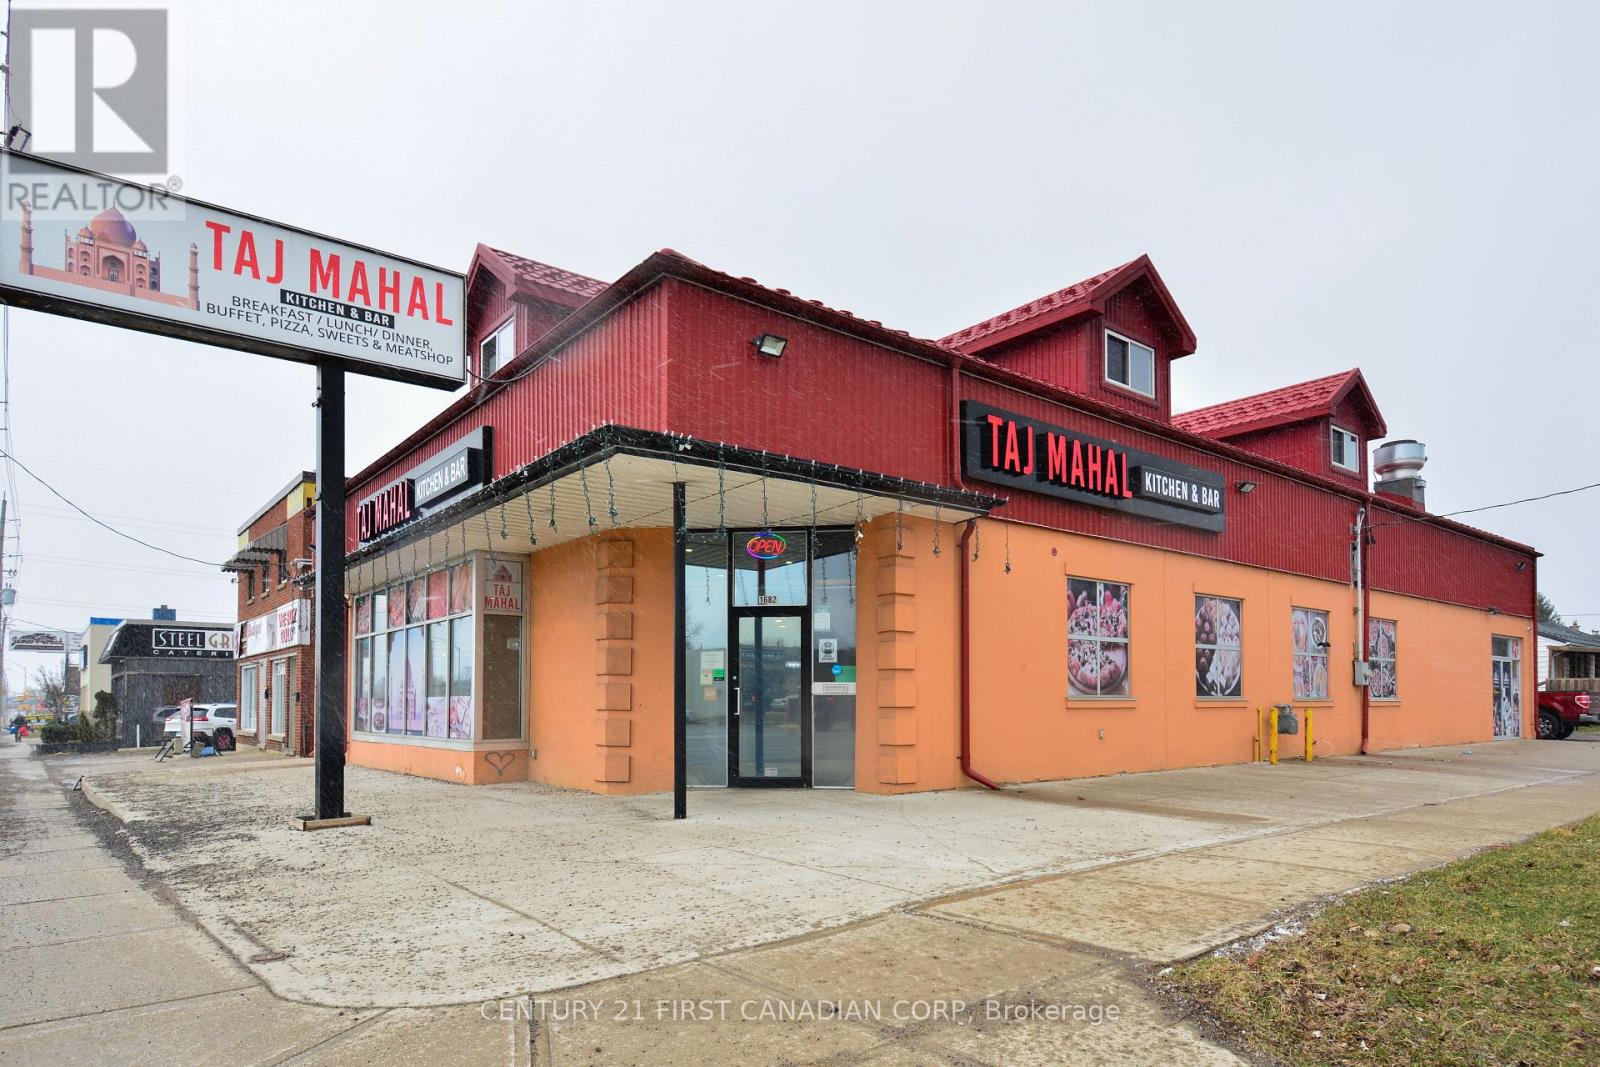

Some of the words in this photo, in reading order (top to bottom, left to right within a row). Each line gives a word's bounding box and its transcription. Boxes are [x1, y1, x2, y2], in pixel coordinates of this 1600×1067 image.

[205, 220, 284, 285] TAJ
[309, 248, 453, 327] MAHAL
[232, 295, 314, 324] BREAKFAST
[382, 330, 433, 352] DINNER,
[285, 291, 346, 317] KITCHEN
[350, 307, 359, 320] &
[364, 310, 390, 327] BAR
[206, 303, 266, 327] BUFFET,
[270, 317, 314, 338] PIZZA,
[317, 327, 369, 348] SWEETS
[373, 340, 382, 351] &
[386, 343, 453, 366] MEATSHOP
[987, 414, 1034, 476] TAJ
[1047, 432, 1133, 499] MAHAL
[416, 471, 444, 501] KITCHEN
[444, 466, 449, 487] &
[450, 457, 466, 484] BAR
[1144, 471, 1188, 501] KITCHEN
[1191, 485, 1199, 503] &
[1201, 486, 1220, 509] BAR
[356, 500, 372, 542] TAJ
[374, 478, 411, 534] MAHAL
[750, 539, 785, 555] OPEN
[484, 596, 520, 610] MAHAL
[493, 584, 511, 597] TAJ
[759, 595, 777, 604] 1682
[152, 649, 230, 657] CATERI
[158, 630, 203, 647] STEEL
[208, 632, 231, 649] GR
